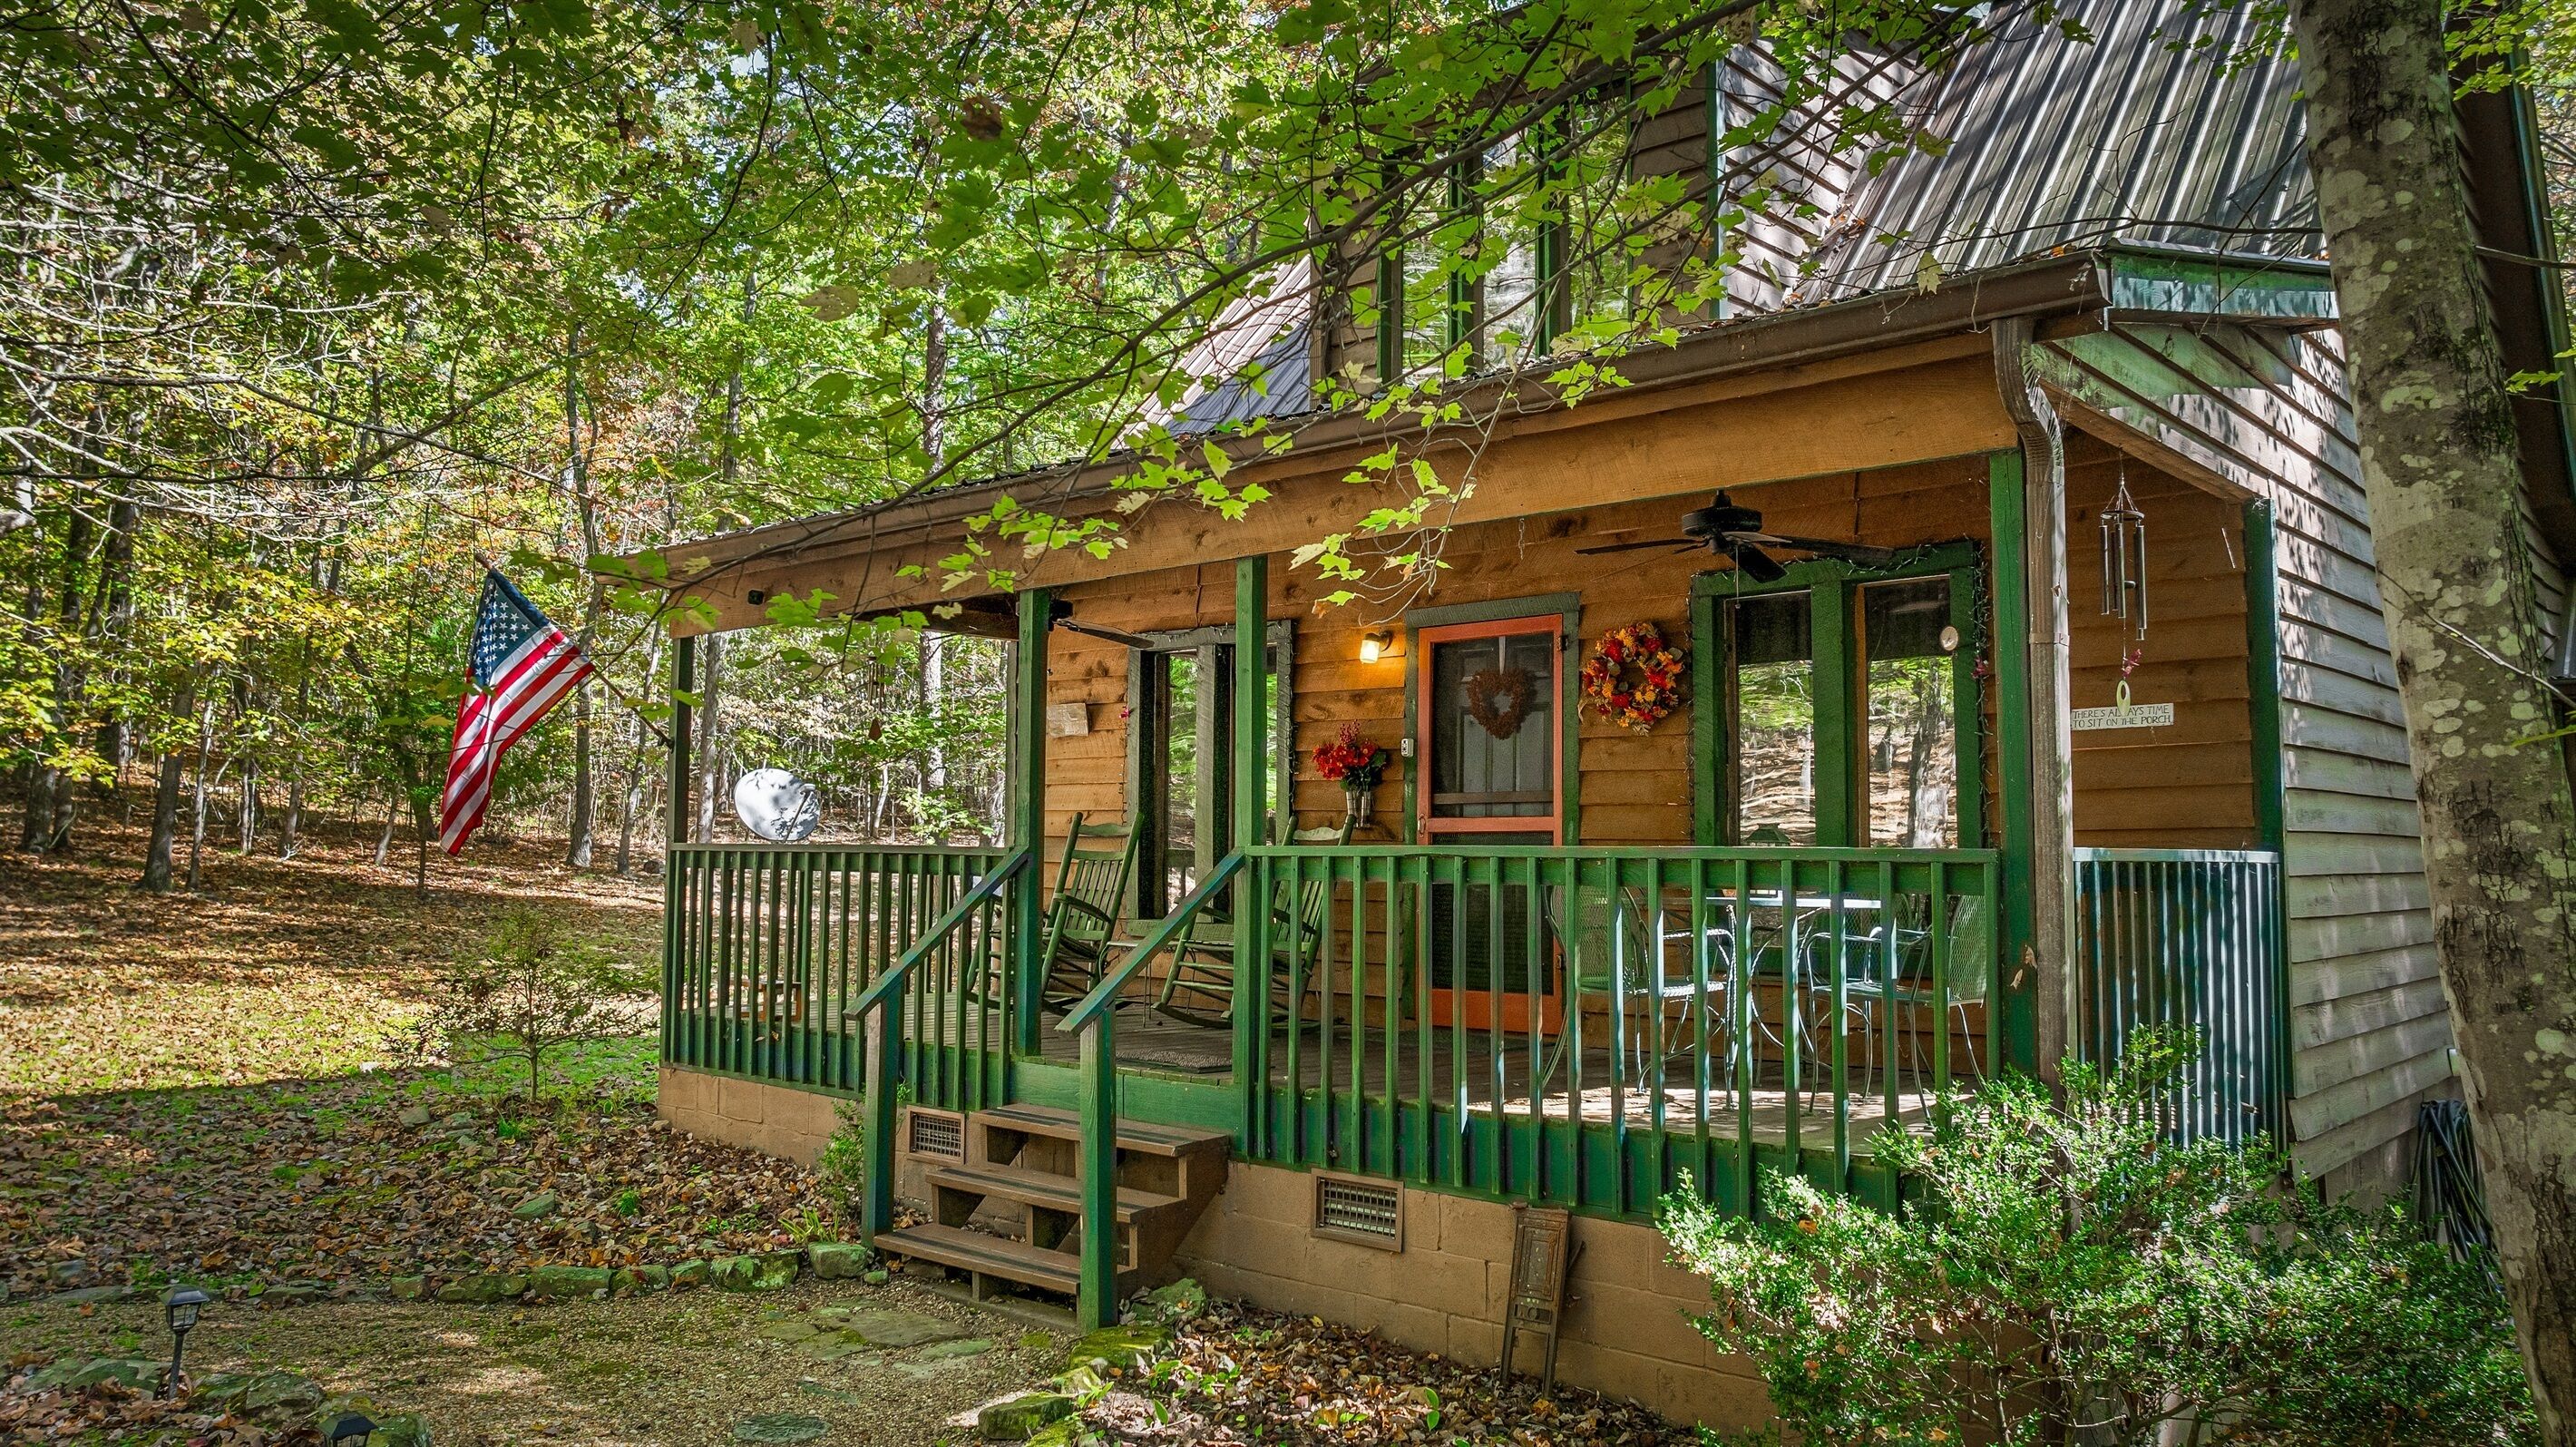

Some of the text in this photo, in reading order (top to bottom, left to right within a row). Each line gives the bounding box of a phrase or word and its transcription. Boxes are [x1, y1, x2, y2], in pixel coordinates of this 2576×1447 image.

[2073, 705, 2170, 719] THERE'S ALAYS TIME
[2073, 719, 2085, 728] TO
[2088, 719, 2103, 727] SIT
[2106, 718, 2118, 726] ON
[2141, 715, 2171, 724] PORCH
